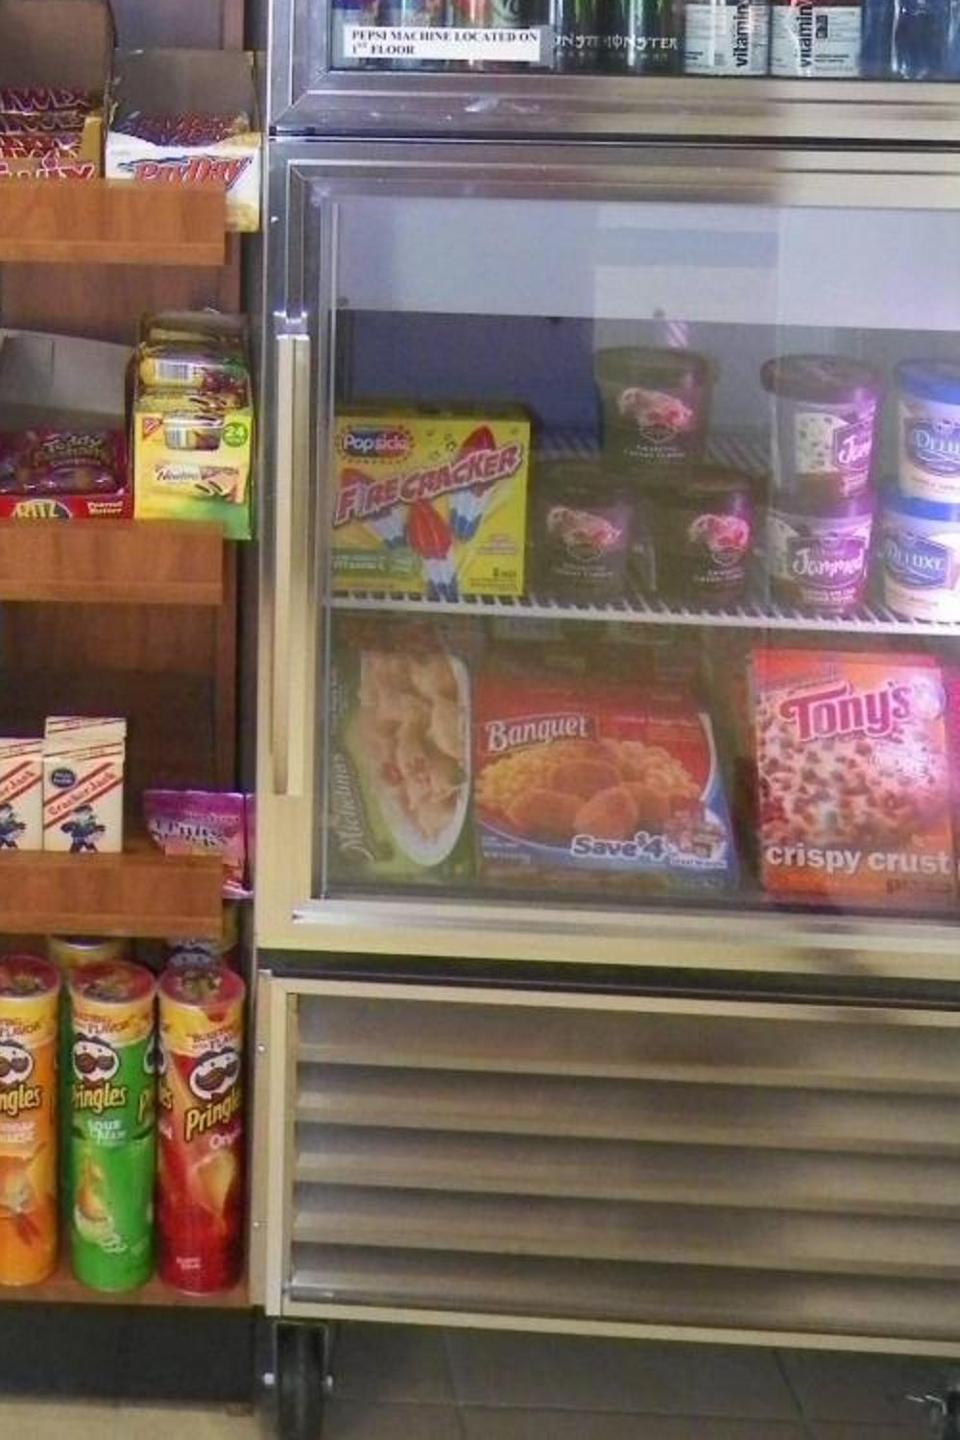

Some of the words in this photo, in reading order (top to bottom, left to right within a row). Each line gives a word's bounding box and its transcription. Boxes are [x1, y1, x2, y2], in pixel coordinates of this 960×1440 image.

[352, 31, 387, 41] PEPSI
[391, 31, 450, 42] MACHINE
[454, 32, 517, 42] LOCATED
[520, 33, 538, 42] ON
[371, 44, 415, 55] FLOOR
[779, 680, 913, 743] Tony's
[486, 714, 589, 752] Banquet
[571, 834, 638, 859] Save
[763, 842, 862, 875] crispy
[867, 850, 952, 875] crust
[185, 1087, 240, 1143] Pringl
